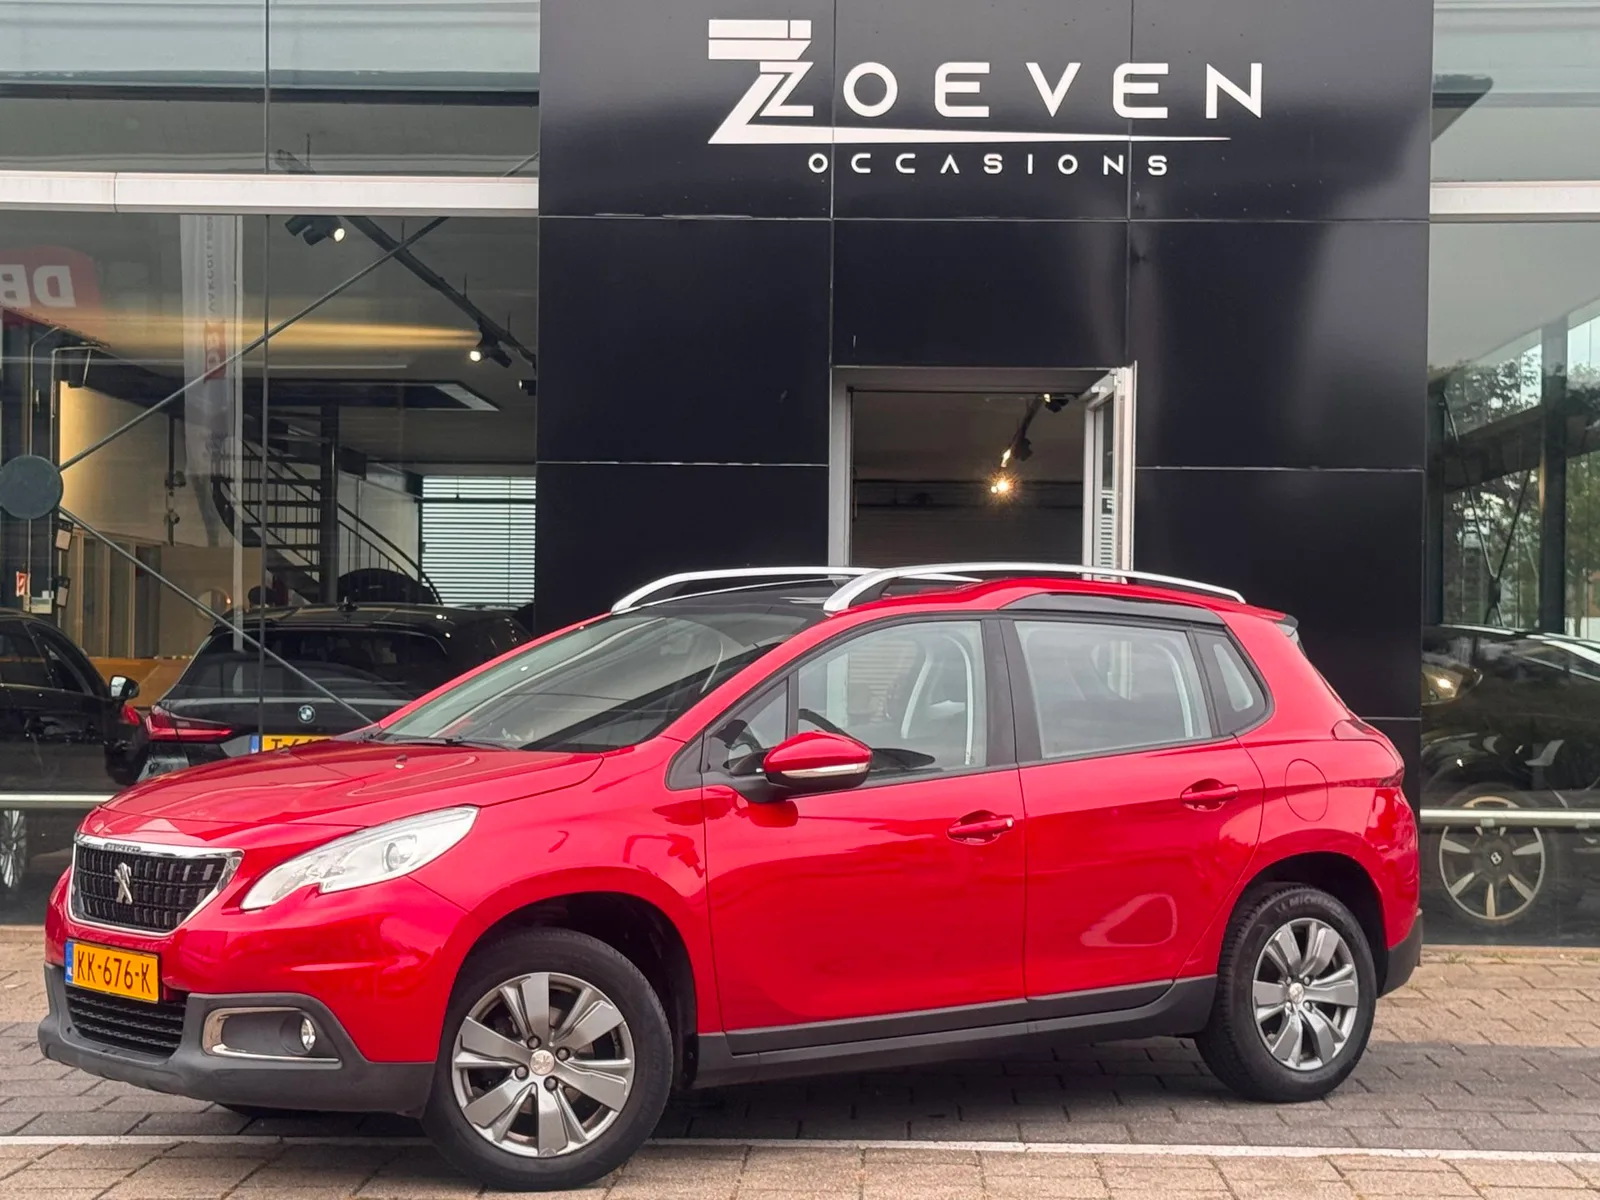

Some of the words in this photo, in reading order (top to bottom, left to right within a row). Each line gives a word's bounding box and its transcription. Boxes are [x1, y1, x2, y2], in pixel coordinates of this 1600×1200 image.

[708, 19, 1262, 145] ZOEVEN
[808, 153, 1168, 176] OCCASIONS
[77, 950, 152, 994] KK-676-K
